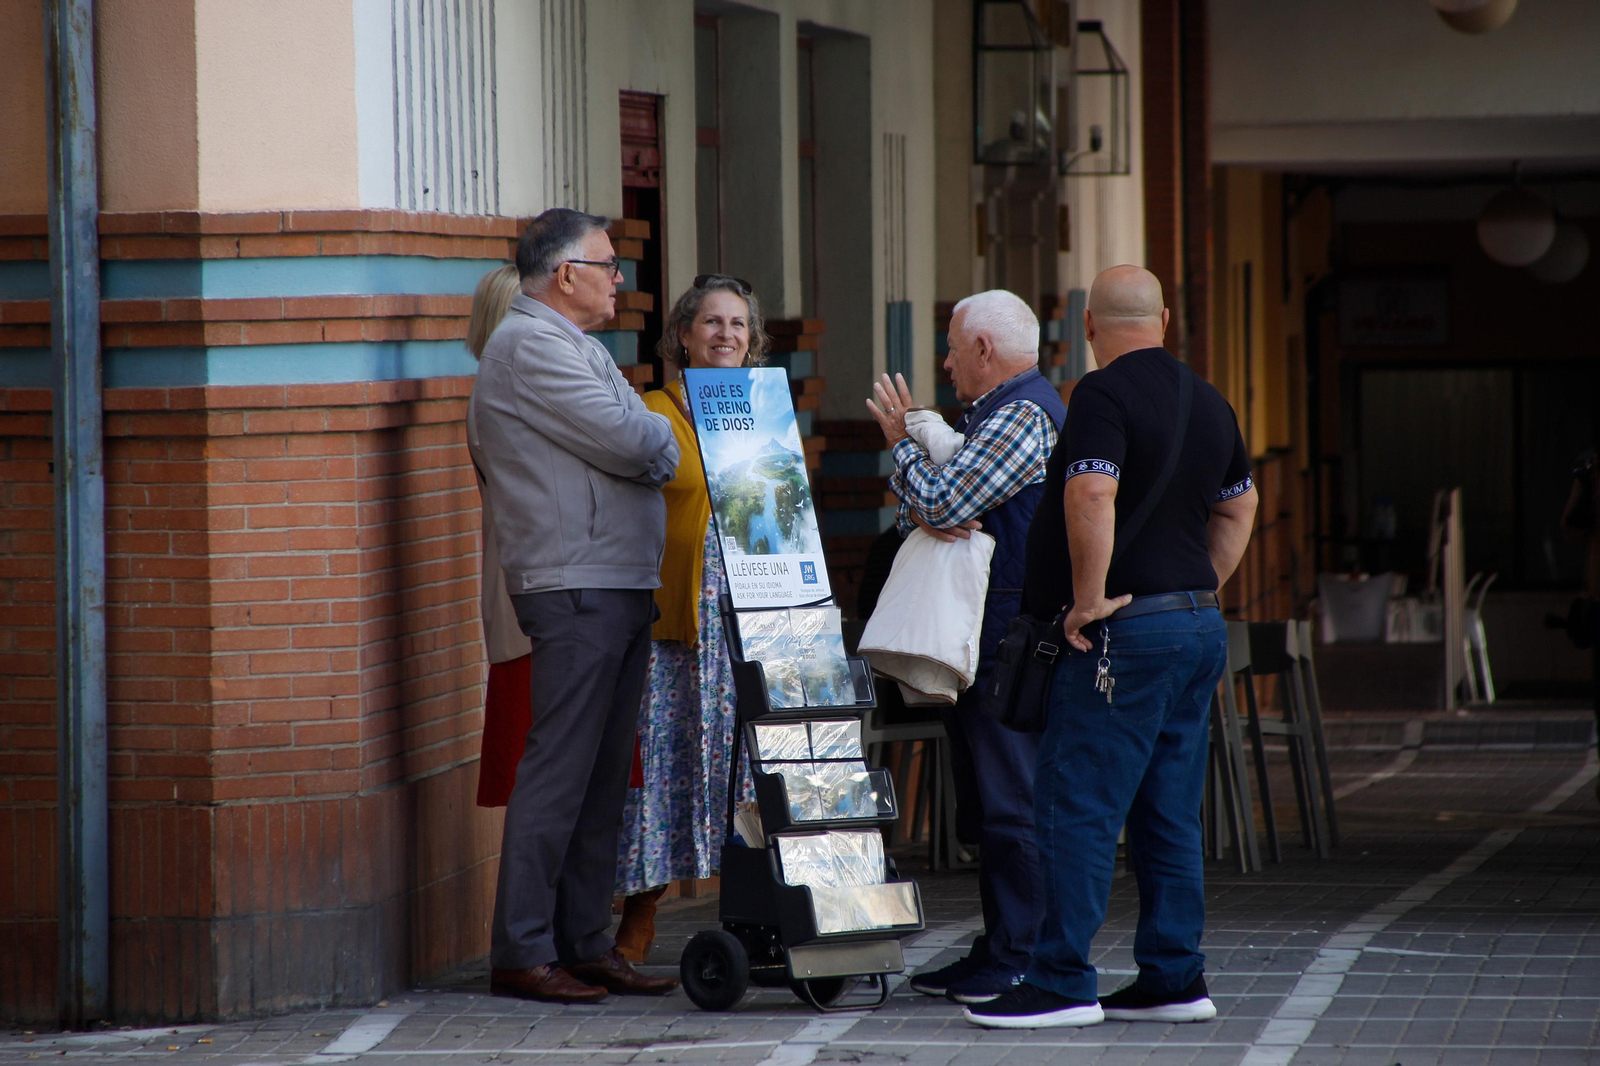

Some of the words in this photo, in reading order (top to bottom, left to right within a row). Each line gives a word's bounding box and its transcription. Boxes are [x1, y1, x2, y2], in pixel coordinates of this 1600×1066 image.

[699, 381, 727, 399] ¿QUÉ
[729, 384, 744, 398] ES
[701, 401, 716, 415] EL
[717, 401, 751, 415] REINO
[705, 418, 720, 431] DE
[722, 418, 755, 431] DIOS?
[731, 559, 769, 577] LLÉVESE
[770, 561, 790, 576] UNA
[804, 564, 813, 574] JW
[766, 581, 783, 589] IDIOMA
[737, 592, 746, 600] ASK
[746, 592, 756, 600] FOR
[756, 591, 769, 599] YOUR
[769, 590, 793, 599] LANGUAGE
